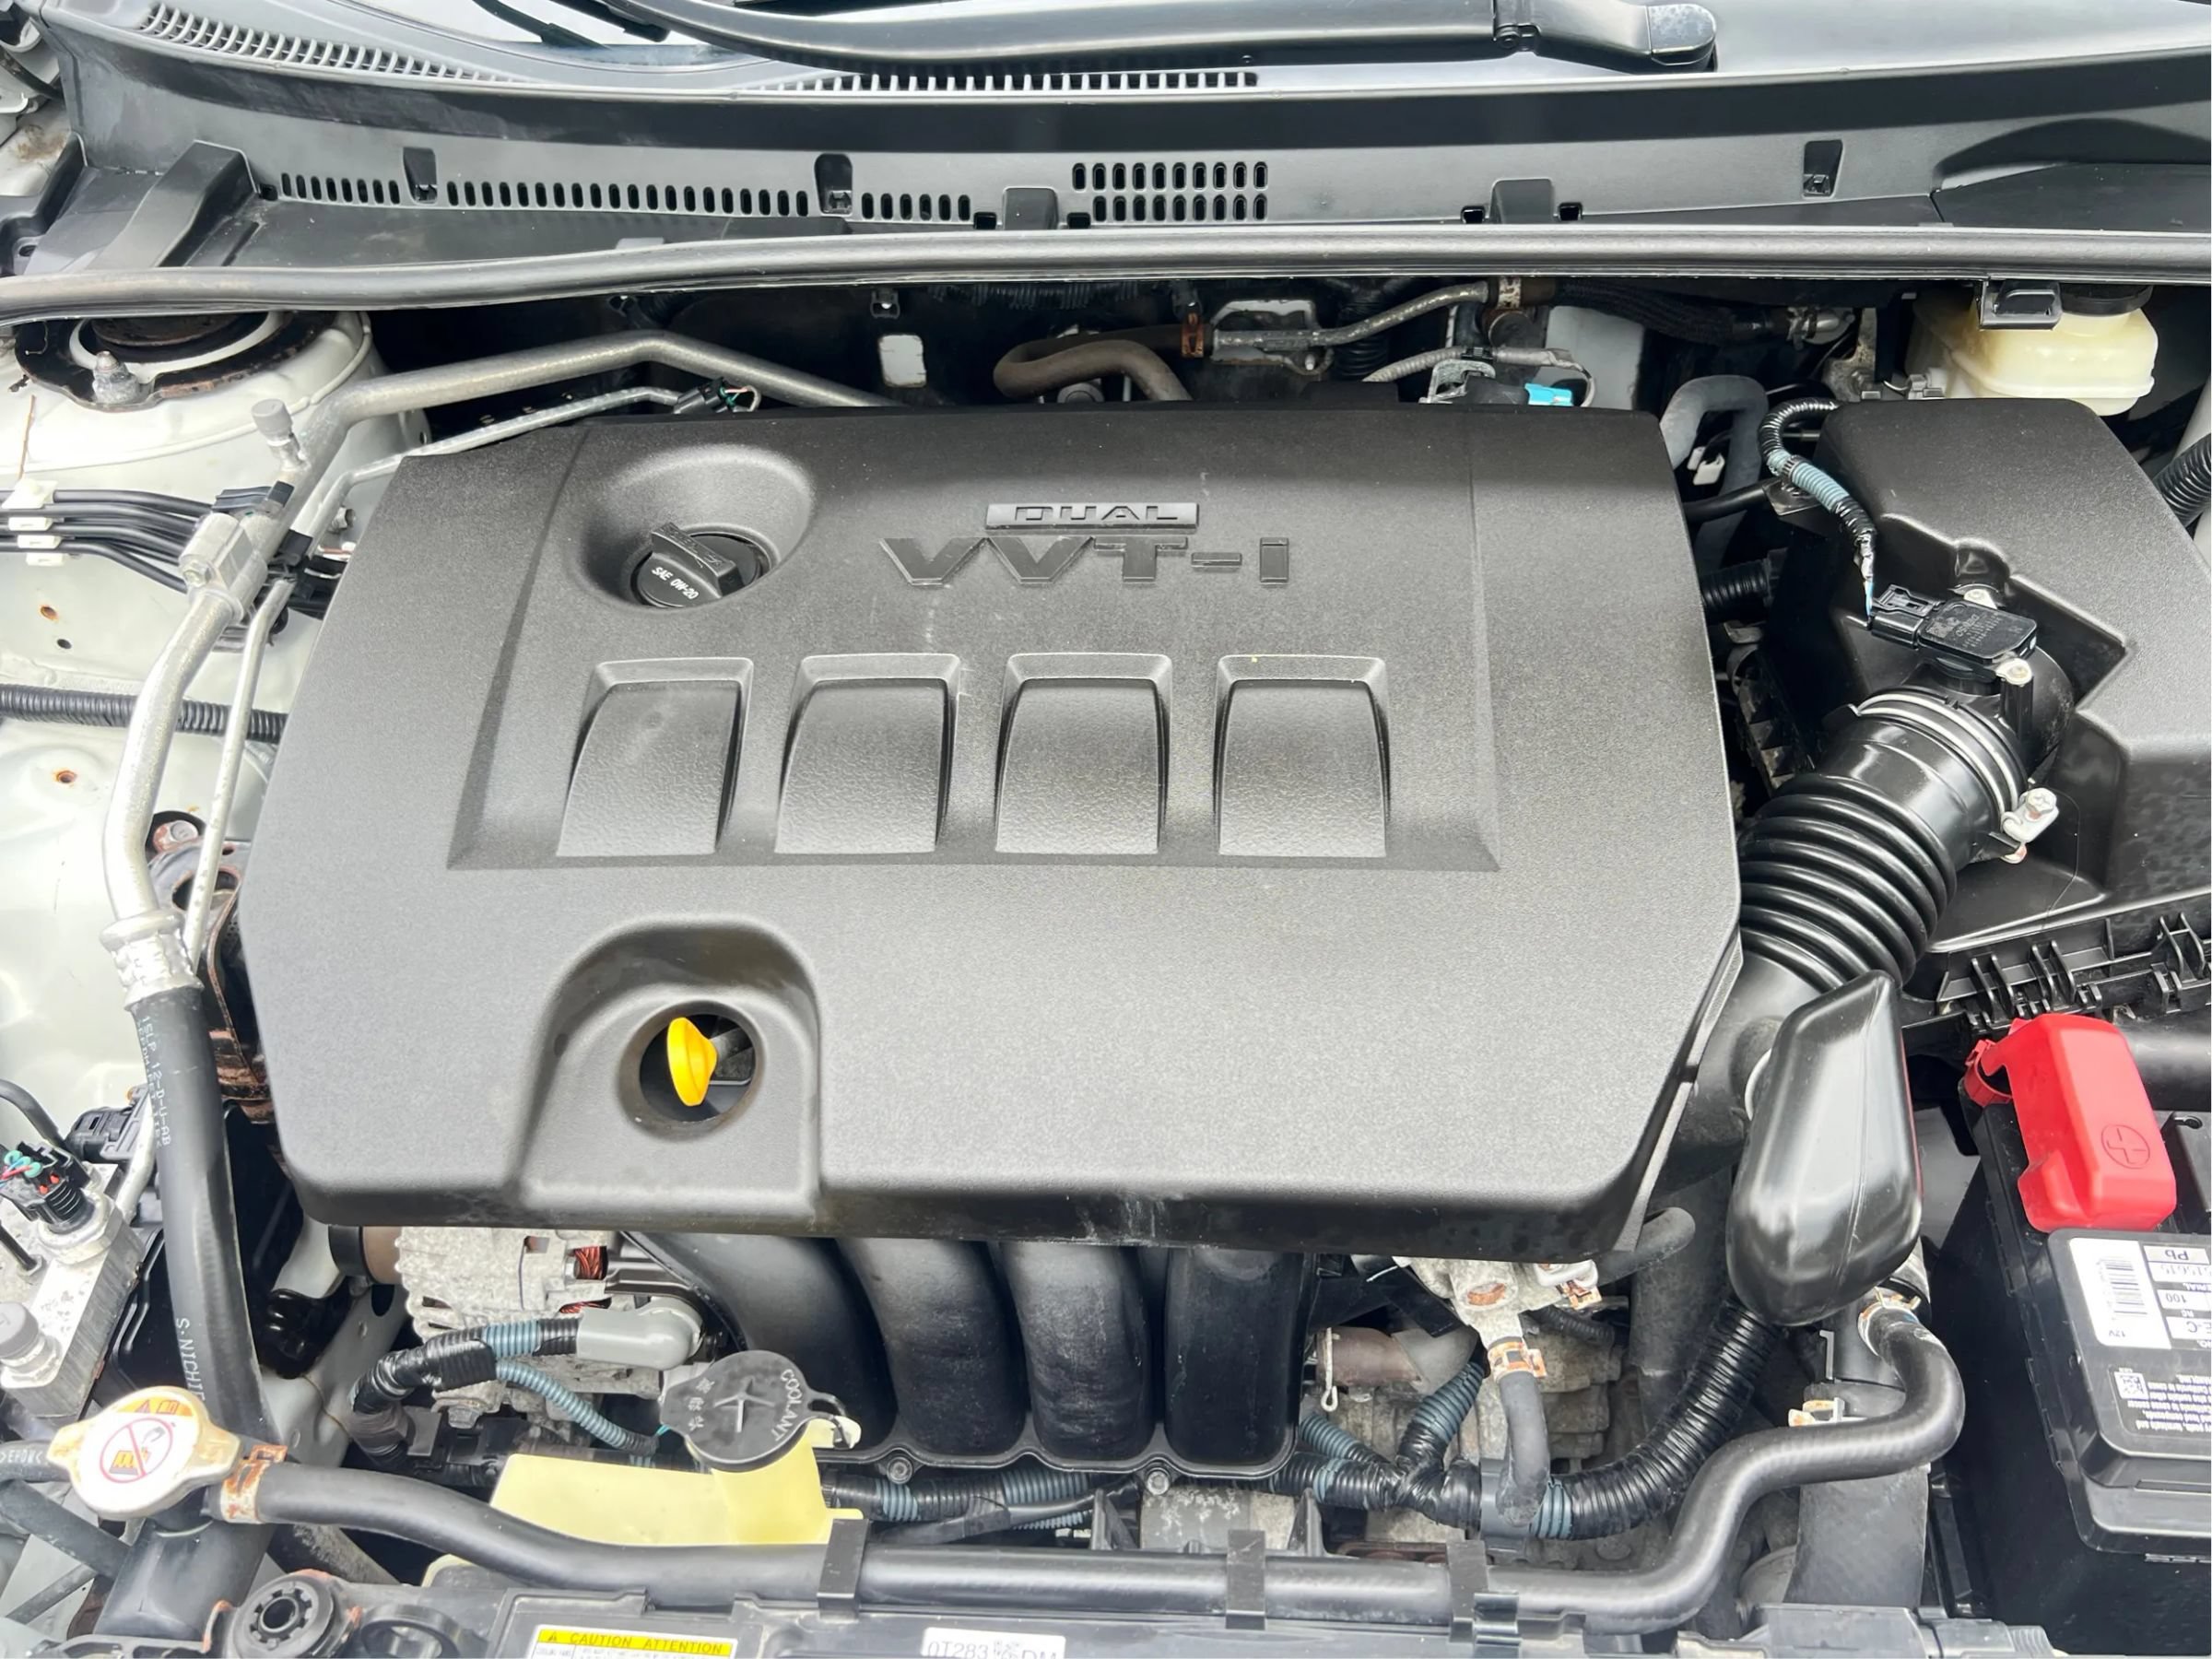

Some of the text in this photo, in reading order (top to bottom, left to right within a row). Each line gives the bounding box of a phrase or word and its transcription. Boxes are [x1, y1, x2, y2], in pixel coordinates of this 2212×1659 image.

[1015, 504, 1179, 522] DUAL
[652, 566, 700, 600] SAE 0W-20
[1956, 613, 1981, 637] DENSO
[2164, 1249, 2190, 1261] Pb
[2166, 1293, 2187, 1303] 100
[771, 1368, 803, 1442] COOLANT
[570, 1632, 723, 1653] CAUTION ATTENTION
